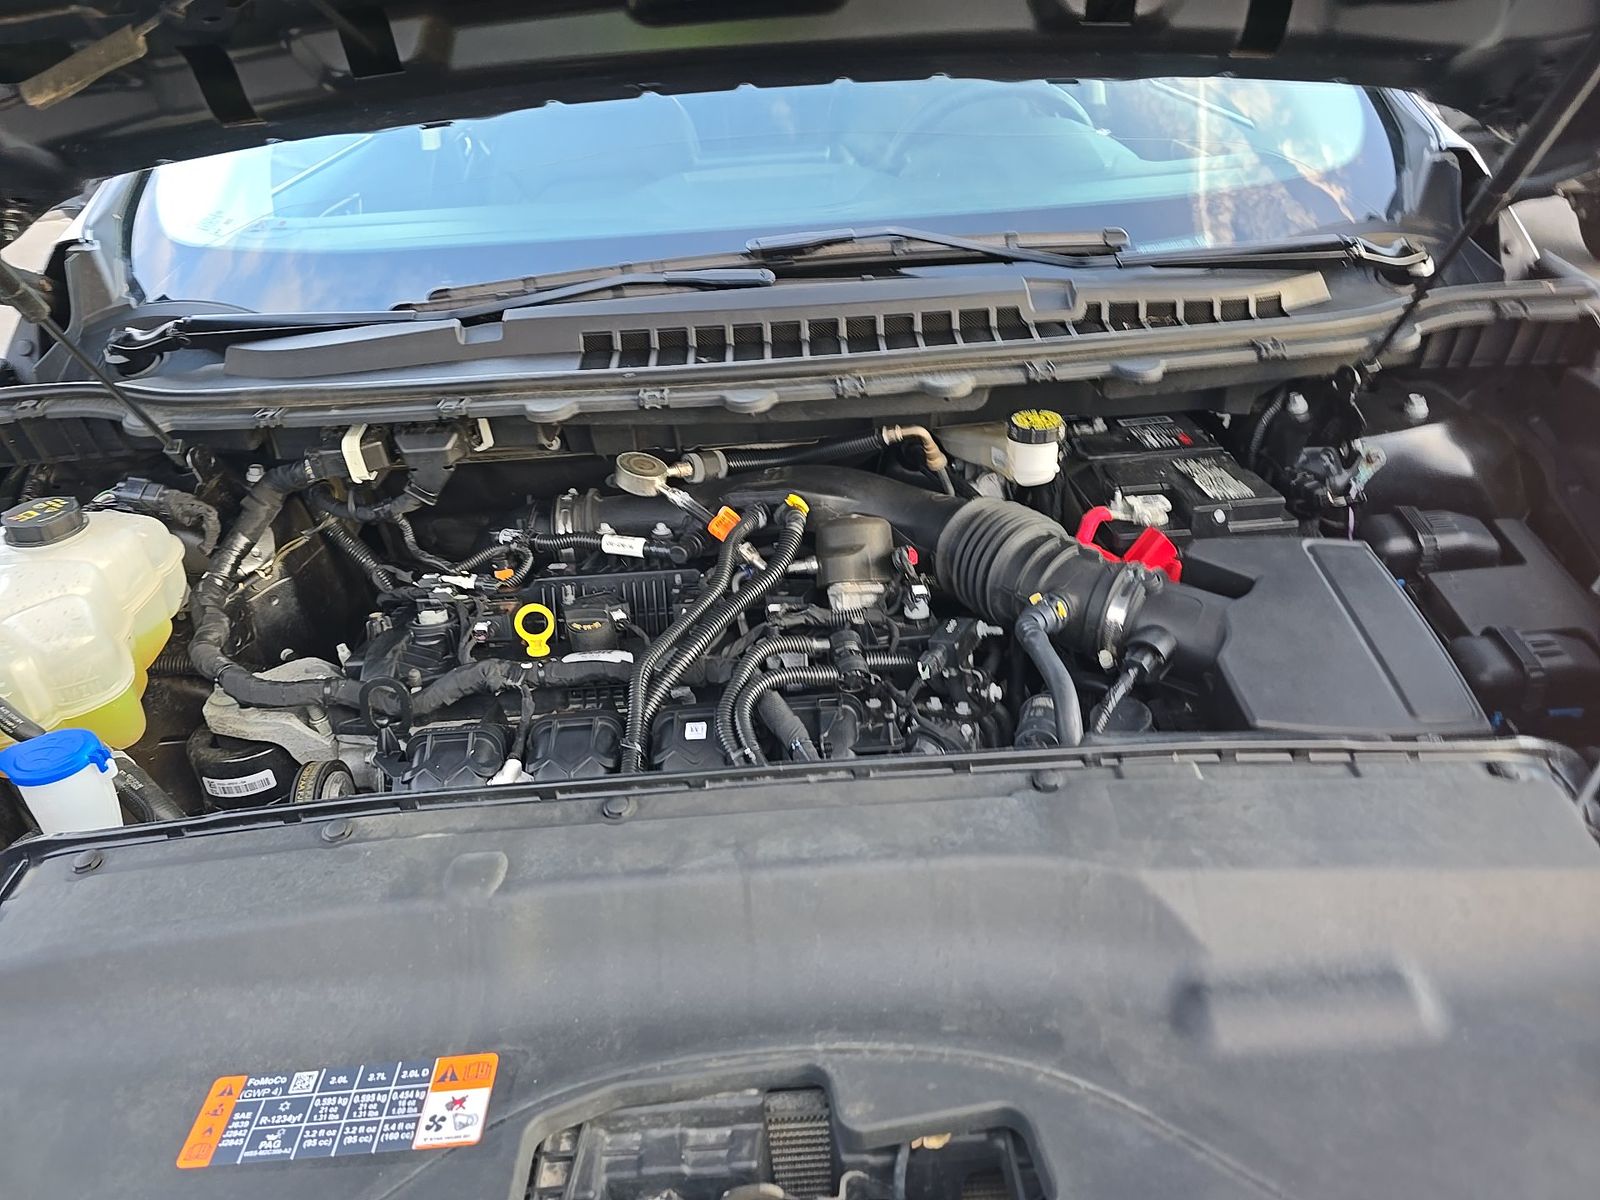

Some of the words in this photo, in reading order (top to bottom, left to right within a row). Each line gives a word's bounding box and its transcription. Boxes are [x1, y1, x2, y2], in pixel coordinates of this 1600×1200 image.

[368, 1072, 386, 1081] 2.7L
[401, 1070, 419, 1078] 2.0L
[247, 1076, 287, 1086] FoMoCo
[330, 1076, 348, 1084] 2.0L
[240, 1089, 270, 1100] (GWP
[272, 1087, 282, 1096] 4)
[377, 1093, 387, 1103] kg
[415, 1090, 426, 1099] kg
[337, 1097, 348, 1106] kg
[260, 1113, 303, 1125] R-1234yf
[344, 1127, 357, 1135] 3.2
[259, 1140, 281, 1149] PAG
[319, 1138, 332, 1147] cc)
